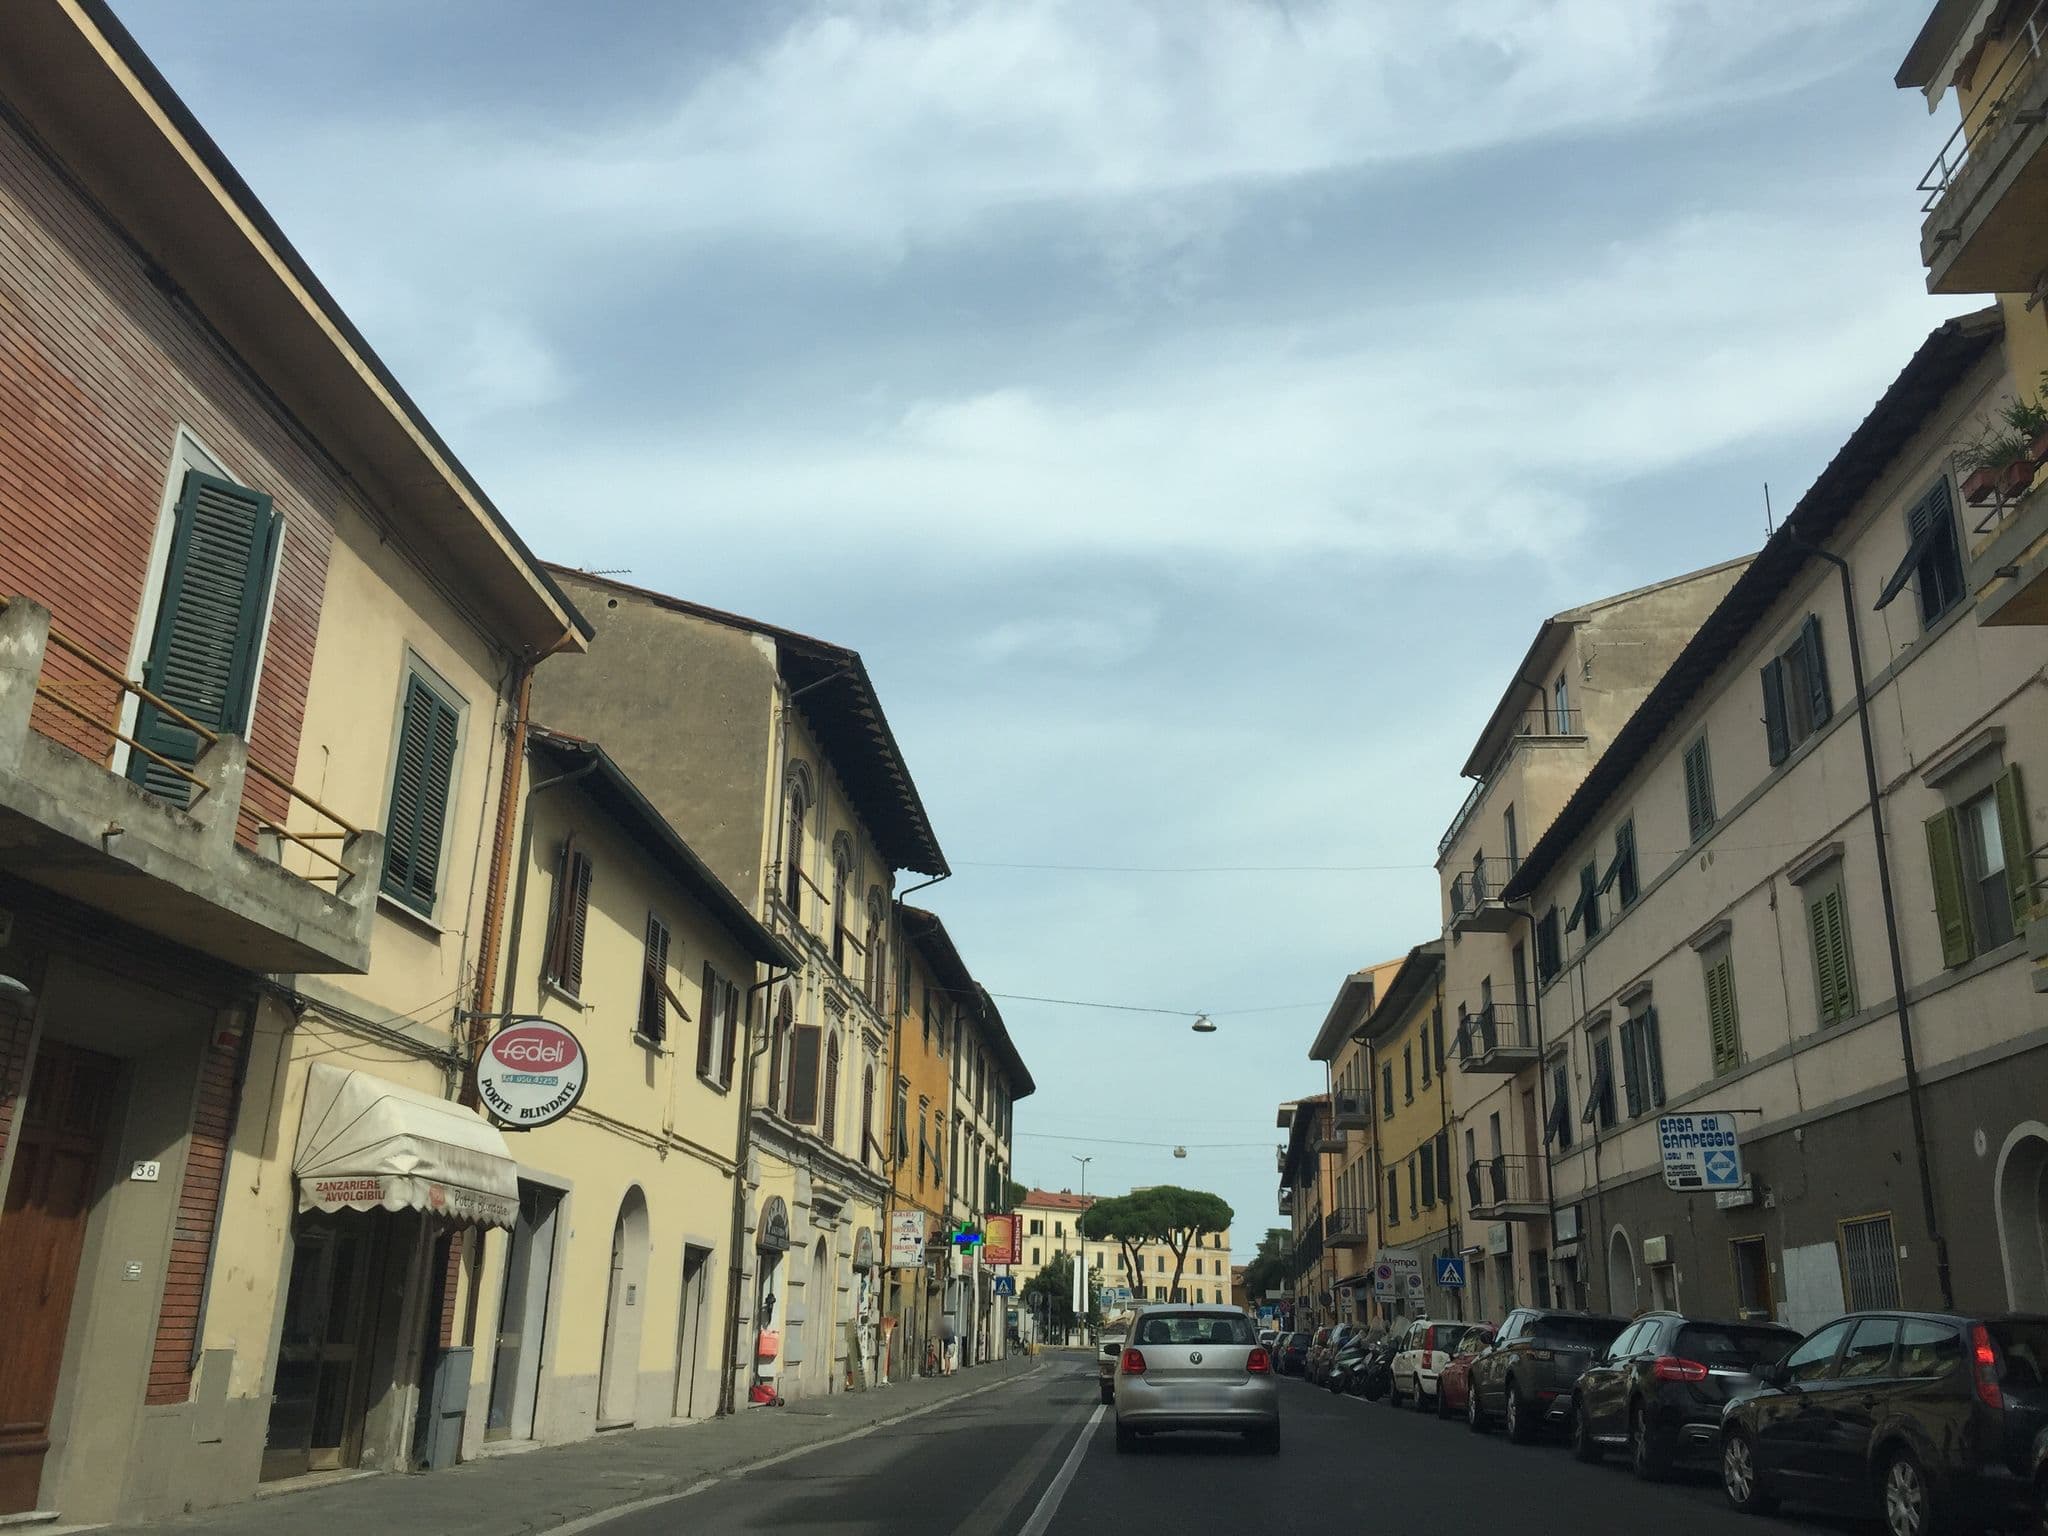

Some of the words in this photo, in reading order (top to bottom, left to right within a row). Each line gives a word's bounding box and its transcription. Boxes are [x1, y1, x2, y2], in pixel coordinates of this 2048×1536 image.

[482, 1078, 513, 1114] PORTE
[520, 1082, 577, 1119] BLINDATE
[1660, 1117, 1693, 1133] CASA
[1662, 1131, 1735, 1148] CAMPEGGIO
[136, 1164, 156, 1177] 38
[316, 1180, 380, 1191] ZANZARIERE
[325, 1190, 386, 1202] AVVOLGIBILI
